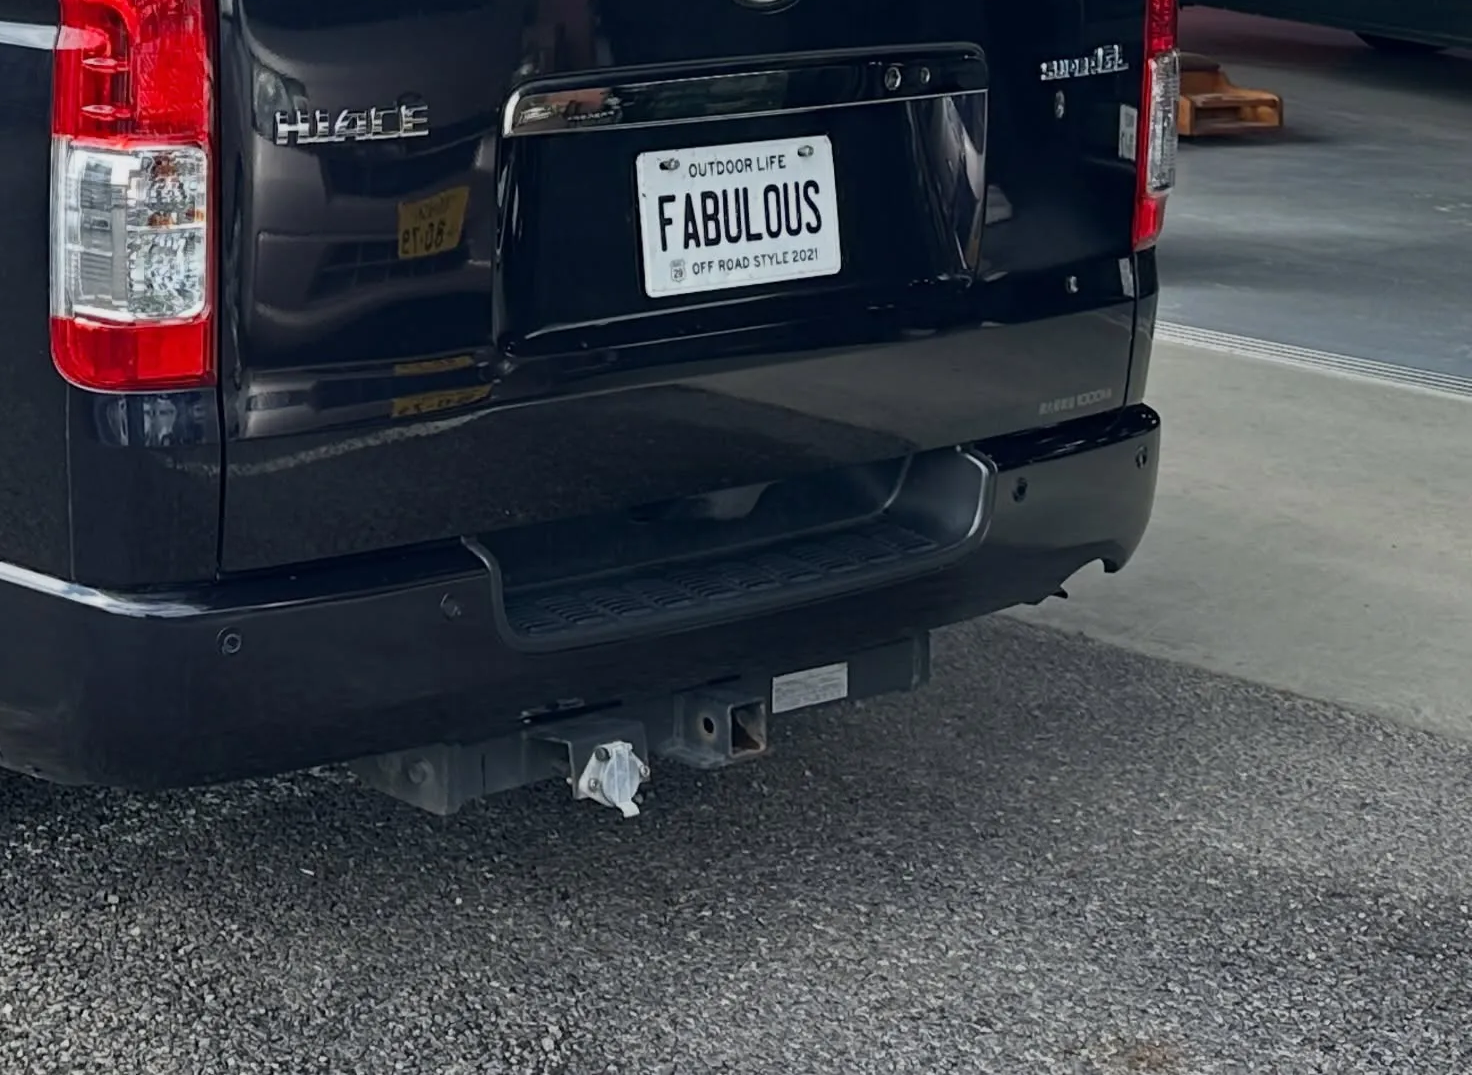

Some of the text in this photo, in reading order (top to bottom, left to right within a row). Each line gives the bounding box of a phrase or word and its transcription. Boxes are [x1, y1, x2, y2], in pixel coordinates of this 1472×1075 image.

[275, 104, 429, 145] HIACE
[688, 154, 787, 178] OUTDOOR LIFE
[658, 179, 823, 252] FABULOUS
[691, 261, 715, 276] OFF
[718, 256, 751, 272] ROAD
[753, 251, 790, 268] STYLE
[792, 247, 819, 263] 2021
